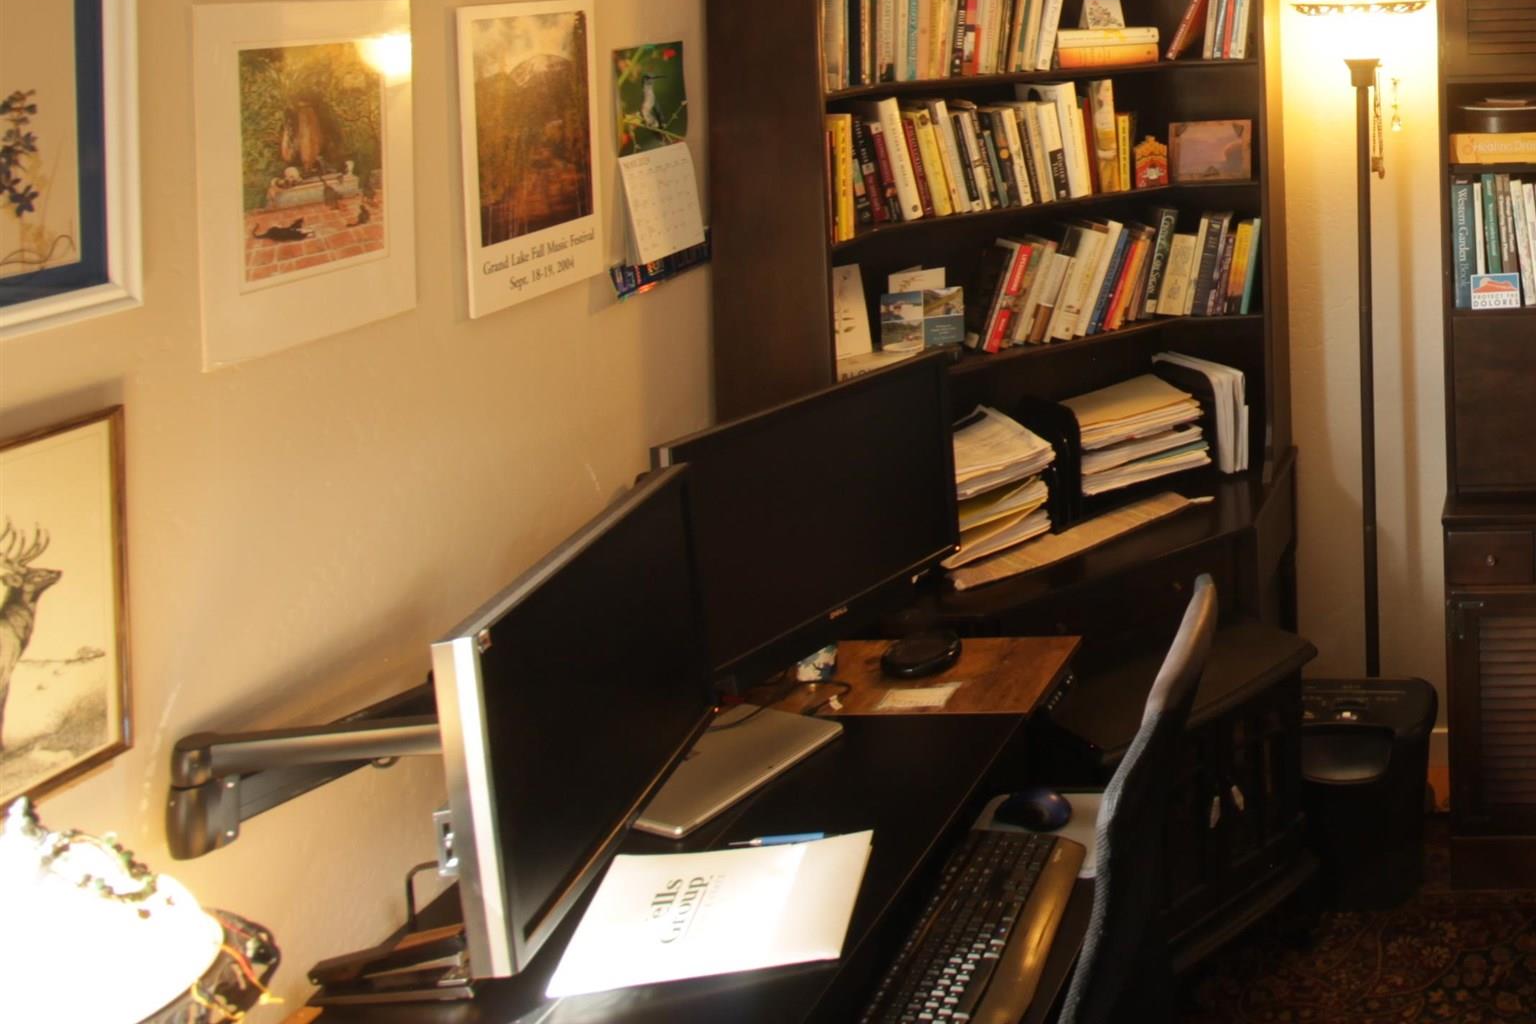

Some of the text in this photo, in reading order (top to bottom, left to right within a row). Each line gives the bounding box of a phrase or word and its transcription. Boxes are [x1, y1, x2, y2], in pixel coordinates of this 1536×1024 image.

[1456, 188, 1468, 226] Western
[482, 228, 595, 275] Grand Lake Fall Music Festival
[1458, 226, 1470, 261] Garden
